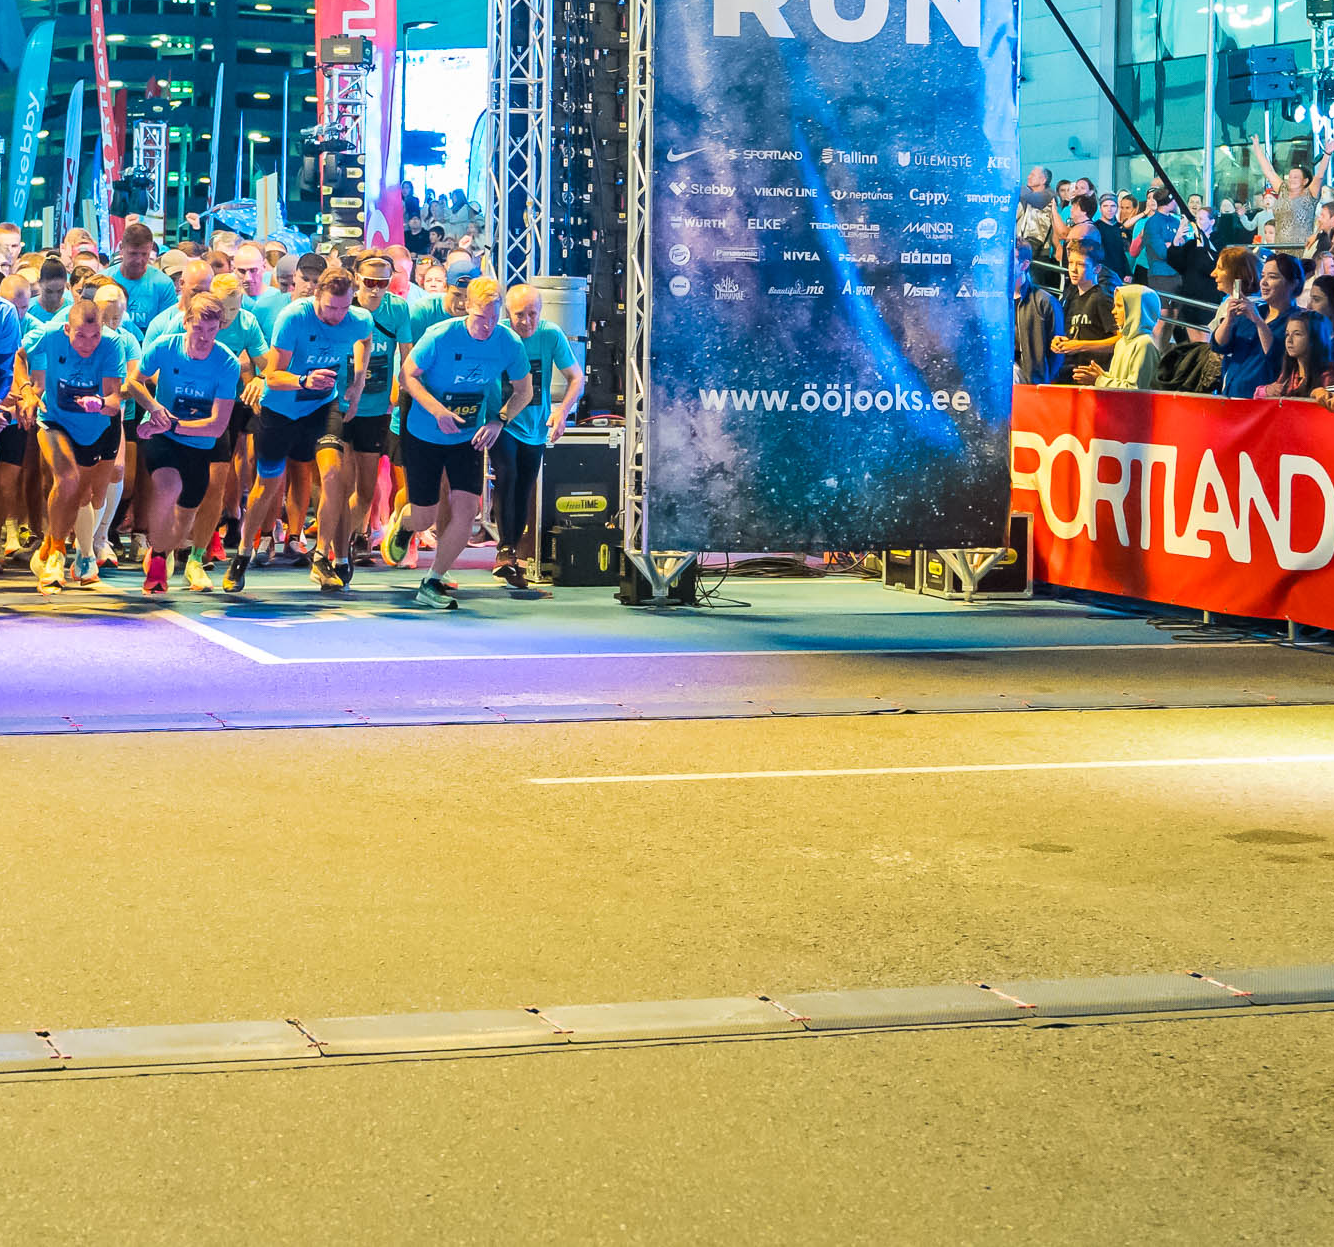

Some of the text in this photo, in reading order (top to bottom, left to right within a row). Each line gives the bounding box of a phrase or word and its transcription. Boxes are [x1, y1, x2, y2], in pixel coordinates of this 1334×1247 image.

[13, 91, 40, 208] Stebby
[744, 149, 803, 161] SPORTLAND
[837, 150, 878, 164] Tallinn
[987, 156, 1012, 169] KFC
[691, 183, 736, 197] Stebby
[754, 187, 818, 197] VIKING LINE
[909, 188, 950, 205] Cappy
[967, 193, 1011, 206] smartpost
[747, 218, 781, 230] ELKE
[809, 221, 880, 232] TECHNOPOLIS
[902, 222, 954, 234] MAINOR
[783, 251, 821, 262] NIVEA
[175, 386, 205, 397] RUN
[699, 384, 971, 417] www.ööjooks.ee
